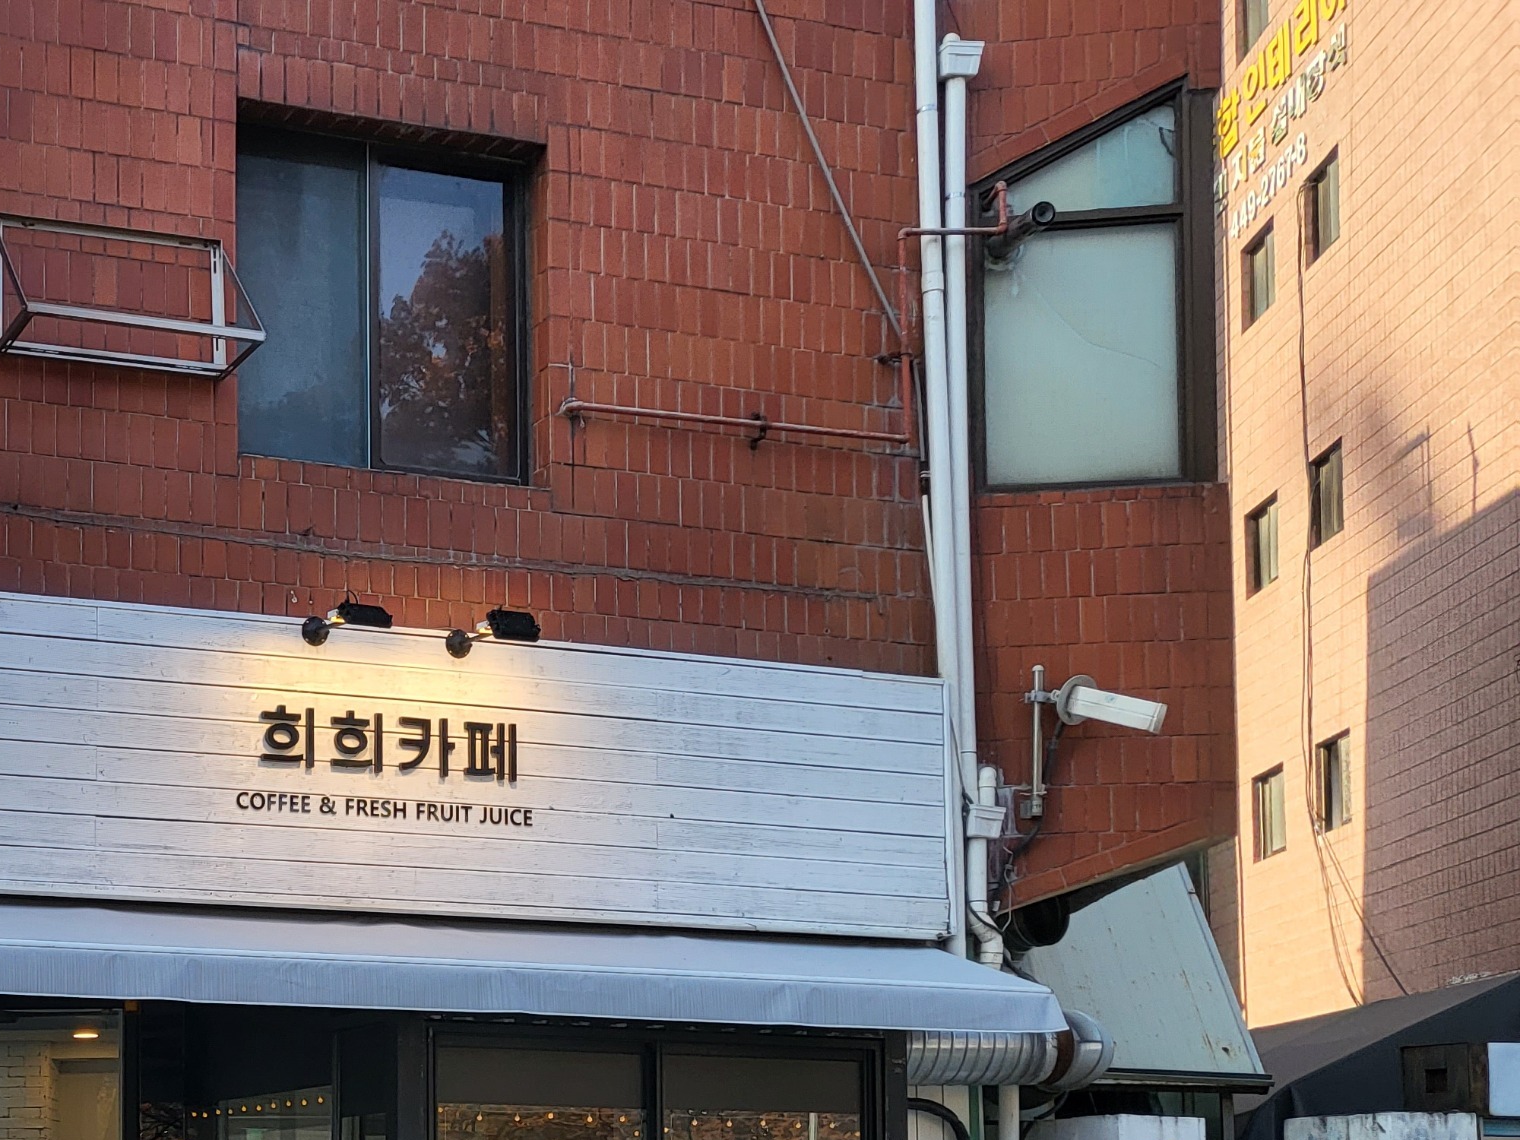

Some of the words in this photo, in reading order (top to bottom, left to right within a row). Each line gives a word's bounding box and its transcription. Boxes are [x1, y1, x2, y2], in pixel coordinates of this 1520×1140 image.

[1230, 132, 1308, 238] 449-2767-8
[260, 704, 518, 783] 희희카페
[236, 792, 311, 814] COFFEE
[319, 796, 337, 815] &
[345, 798, 407, 819] FRESH
[416, 803, 472, 823] FRUIT
[479, 806, 533, 826] JUICE
